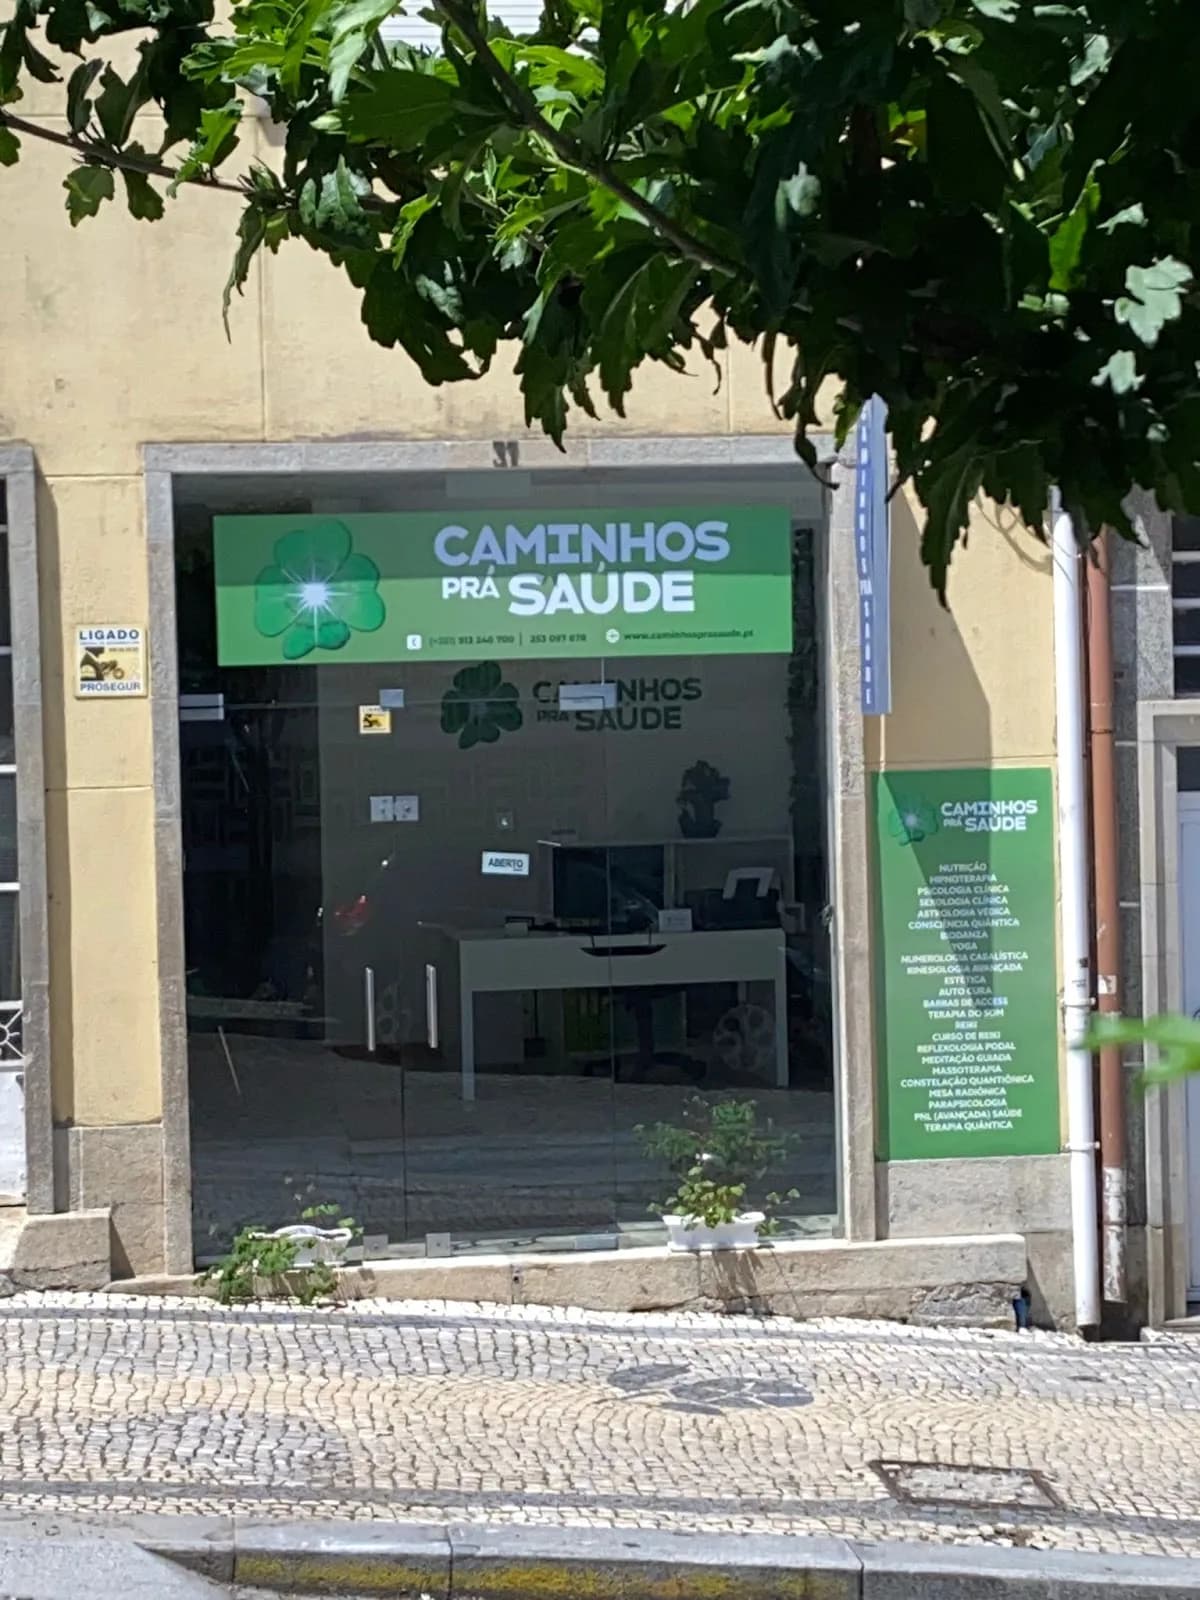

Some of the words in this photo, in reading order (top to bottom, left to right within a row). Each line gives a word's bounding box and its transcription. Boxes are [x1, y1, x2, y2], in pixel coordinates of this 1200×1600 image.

[434, 521, 730, 566] CAMINHOS
[442, 565, 500, 599] PRÁ
[508, 562, 695, 616] SAÚDE
[80, 629, 140, 640] LIGADO
[80, 681, 141, 692] PROSEGUR
[532, 678, 703, 704] CNHOS
[940, 800, 1038, 816] CAMINHOS
[943, 816, 962, 827] PRÁ
[965, 813, 1026, 832] SAÚDE
[488, 857, 524, 869] ABERTO
[939, 862, 987, 873] NUTRIÇÃO
[929, 874, 997, 884] HIPNOTERAPIA
[917, 886, 971, 896] PSICOLOGIA
[973, 884, 1009, 894] CLÍNICA
[919, 897, 970, 907] SEXOLOGIA
[971, 895, 1008, 905] CLÍNICA
[917, 908, 975, 918] ASTROLOGIA
[908, 918, 969, 929] CONSCIÊNCIA
[940, 931, 988, 940] BIODANZA
[952, 942, 978, 951] YOGA
[901, 953, 968, 964] NUMEROLOGIA
[944, 975, 986, 985] ESTÉTICA
[939, 988, 965, 996] AUTO
[966, 986, 992, 995] CURA
[923, 999, 959, 1008] BARRAS
[961, 998, 973, 1007] DE
[928, 1010, 966, 1019] TERAPIA
[968, 1009, 982, 1018] DO
[984, 1008, 1004, 1017] SOM
[955, 1020, 978, 1029] REIKI
[932, 1032, 963, 1041] CURSO
[965, 1032, 977, 1040] DE
[978, 1031, 1001, 1039] REIKI
[917, 1043, 984, 1053] REFLEXOLOGIA
[985, 1041, 1016, 1051] PODAL
[921, 1053, 975, 1064] MEDITAÇÃO
[976, 1053, 1012, 1062] GUIADA
[932, 1065, 1002, 1075] MASSOTERAPIA
[900, 1076, 967, 1087] CONSTELAÇÃO
[929, 1088, 953, 1097] MESA
[928, 1098, 1007, 1109] PARAPSICOLOGIA
[914, 1112, 932, 1121] PNL
[934, 1109, 991, 1122] (AVANÇADA)
[992, 1108, 1022, 1118] SAÚDE
[924, 1122, 963, 1132] TERAPIA
